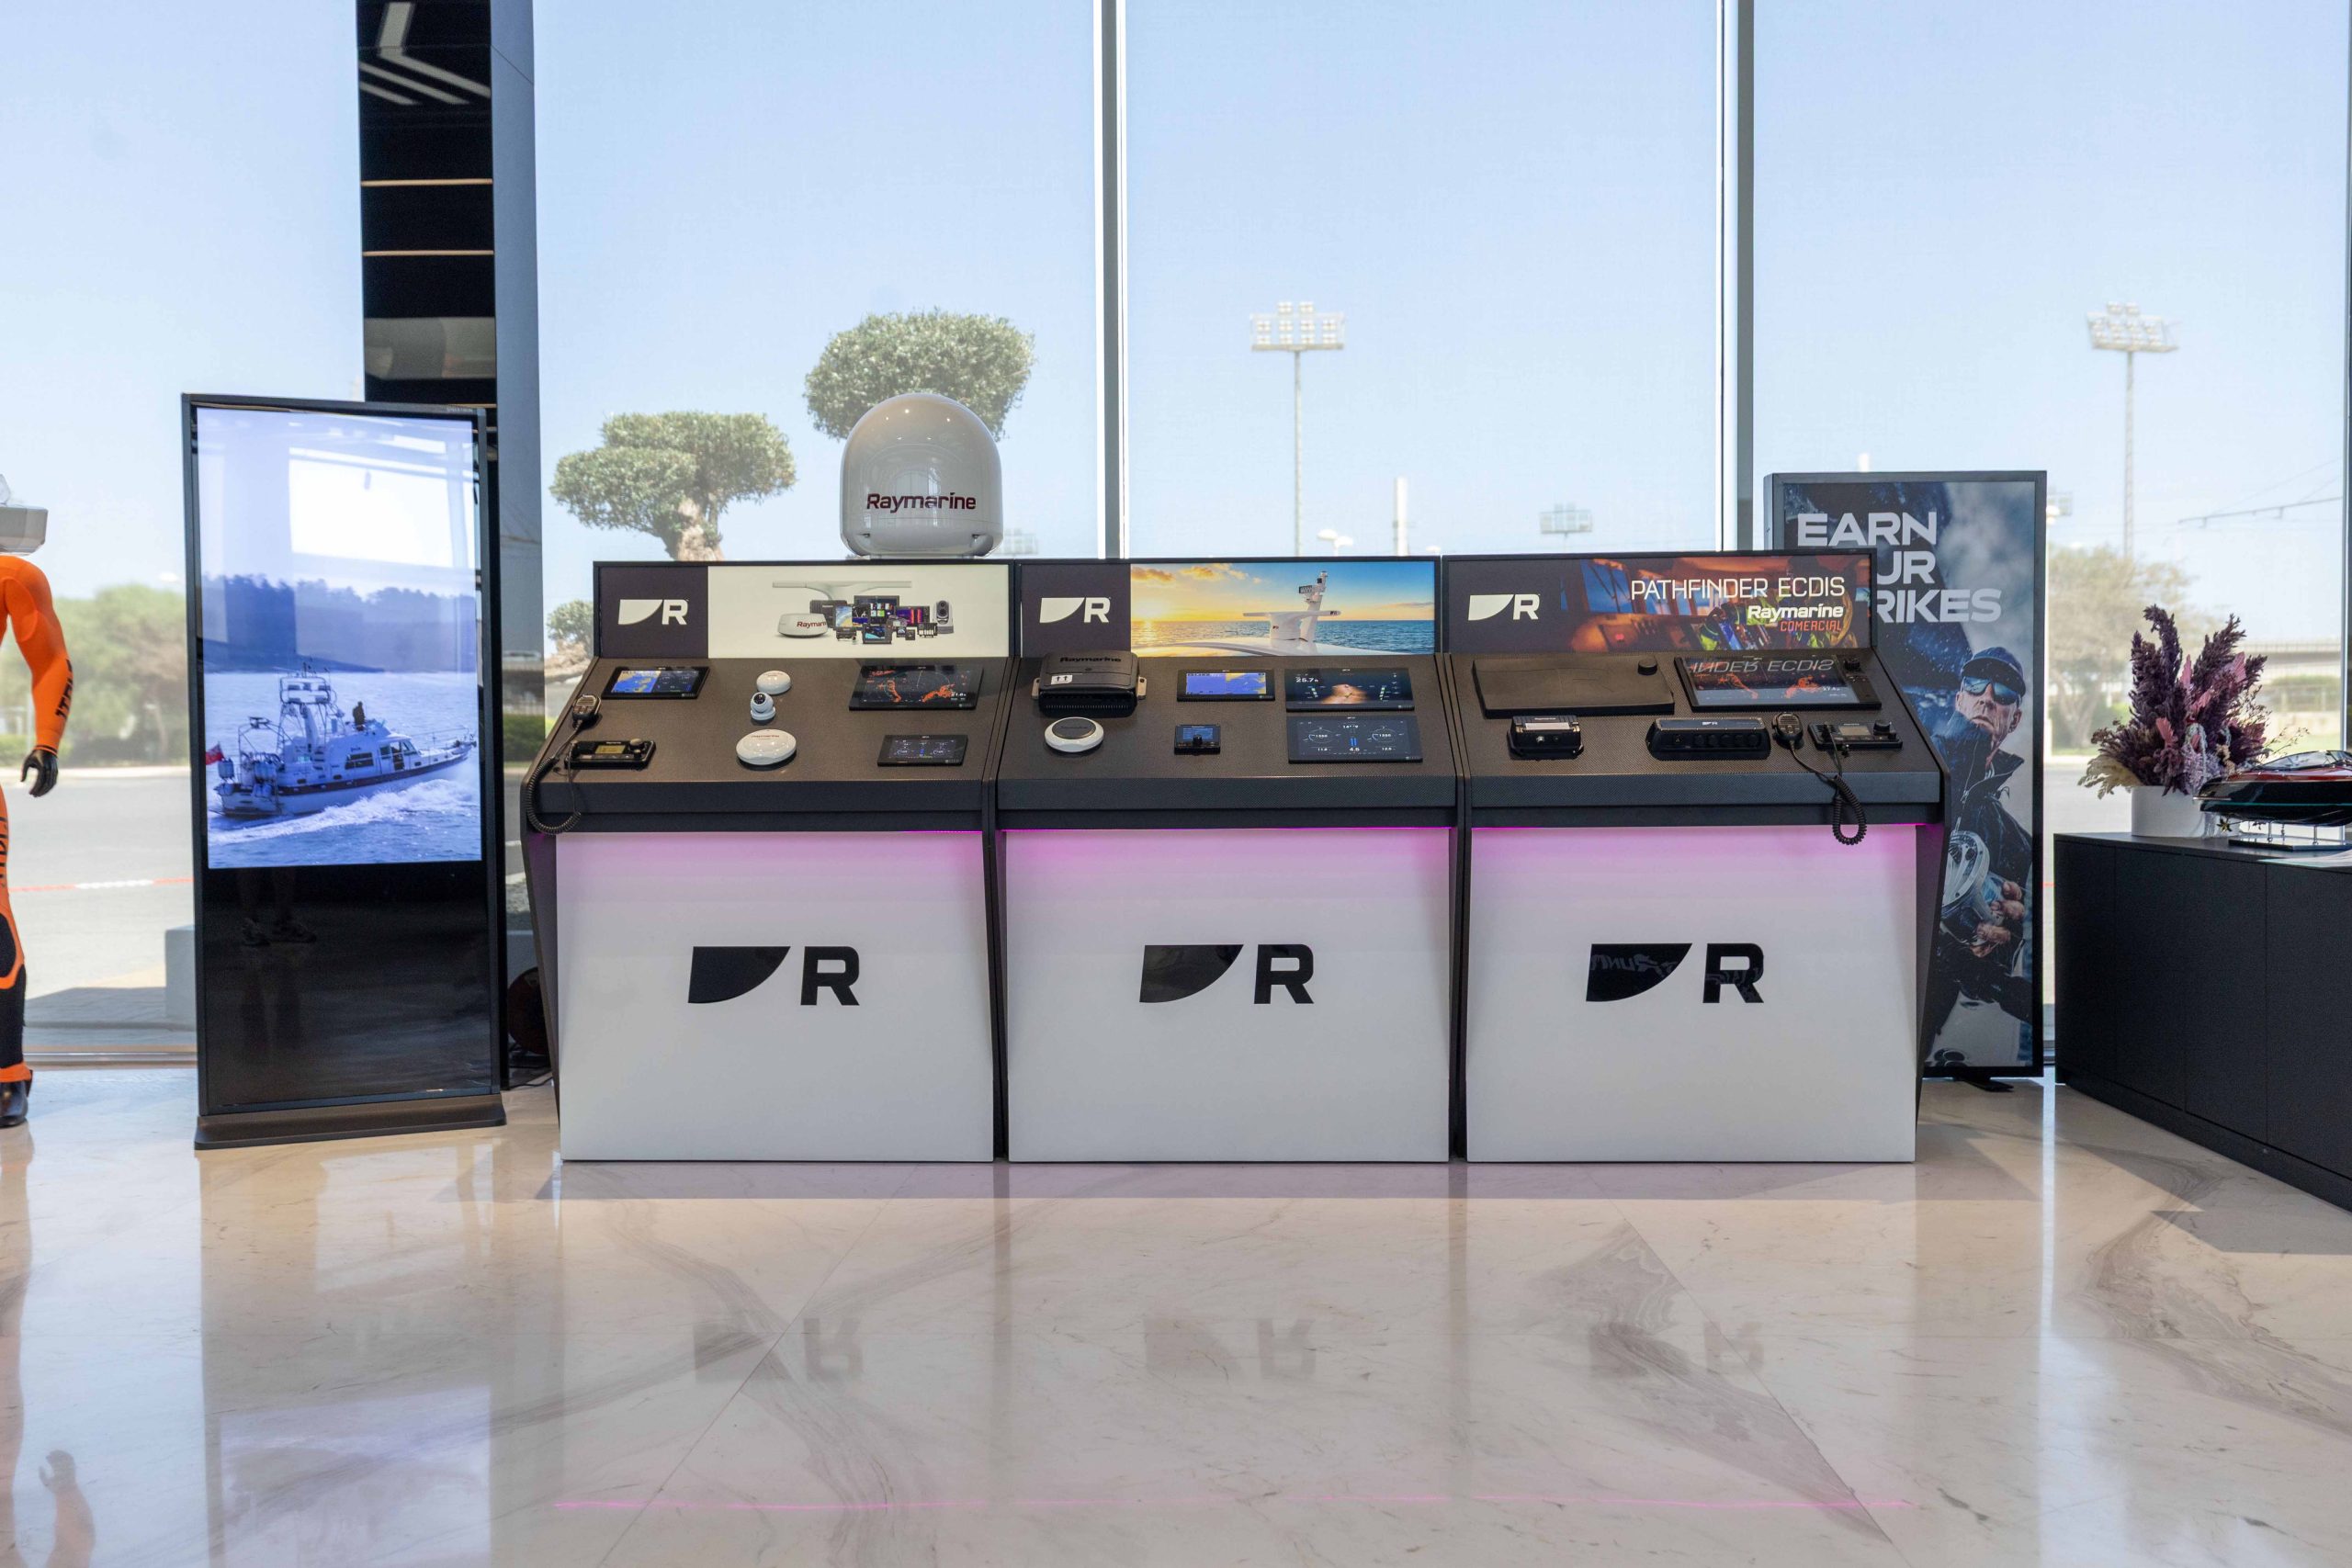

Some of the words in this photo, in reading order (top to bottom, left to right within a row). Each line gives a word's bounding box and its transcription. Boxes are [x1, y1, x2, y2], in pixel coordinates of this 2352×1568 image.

[866, 491, 977, 513] Raymarine
[1797, 512, 1938, 547] EARN
[1877, 550, 1937, 585] UR
[1631, 578, 1769, 600] PATHFINDER
[1778, 577, 1845, 597] ECDIS
[662, 599, 688, 625] R
[1083, 597, 1111, 623] R
[1512, 593, 1541, 620] R
[1747, 604, 1844, 623] Raymarine
[1877, 588, 2002, 624] RIKES
[1780, 620, 1842, 632] COMERCIAL
[801, 946, 860, 1006] R
[1253, 943, 1315, 1005] R
[1702, 942, 1765, 1004] R
